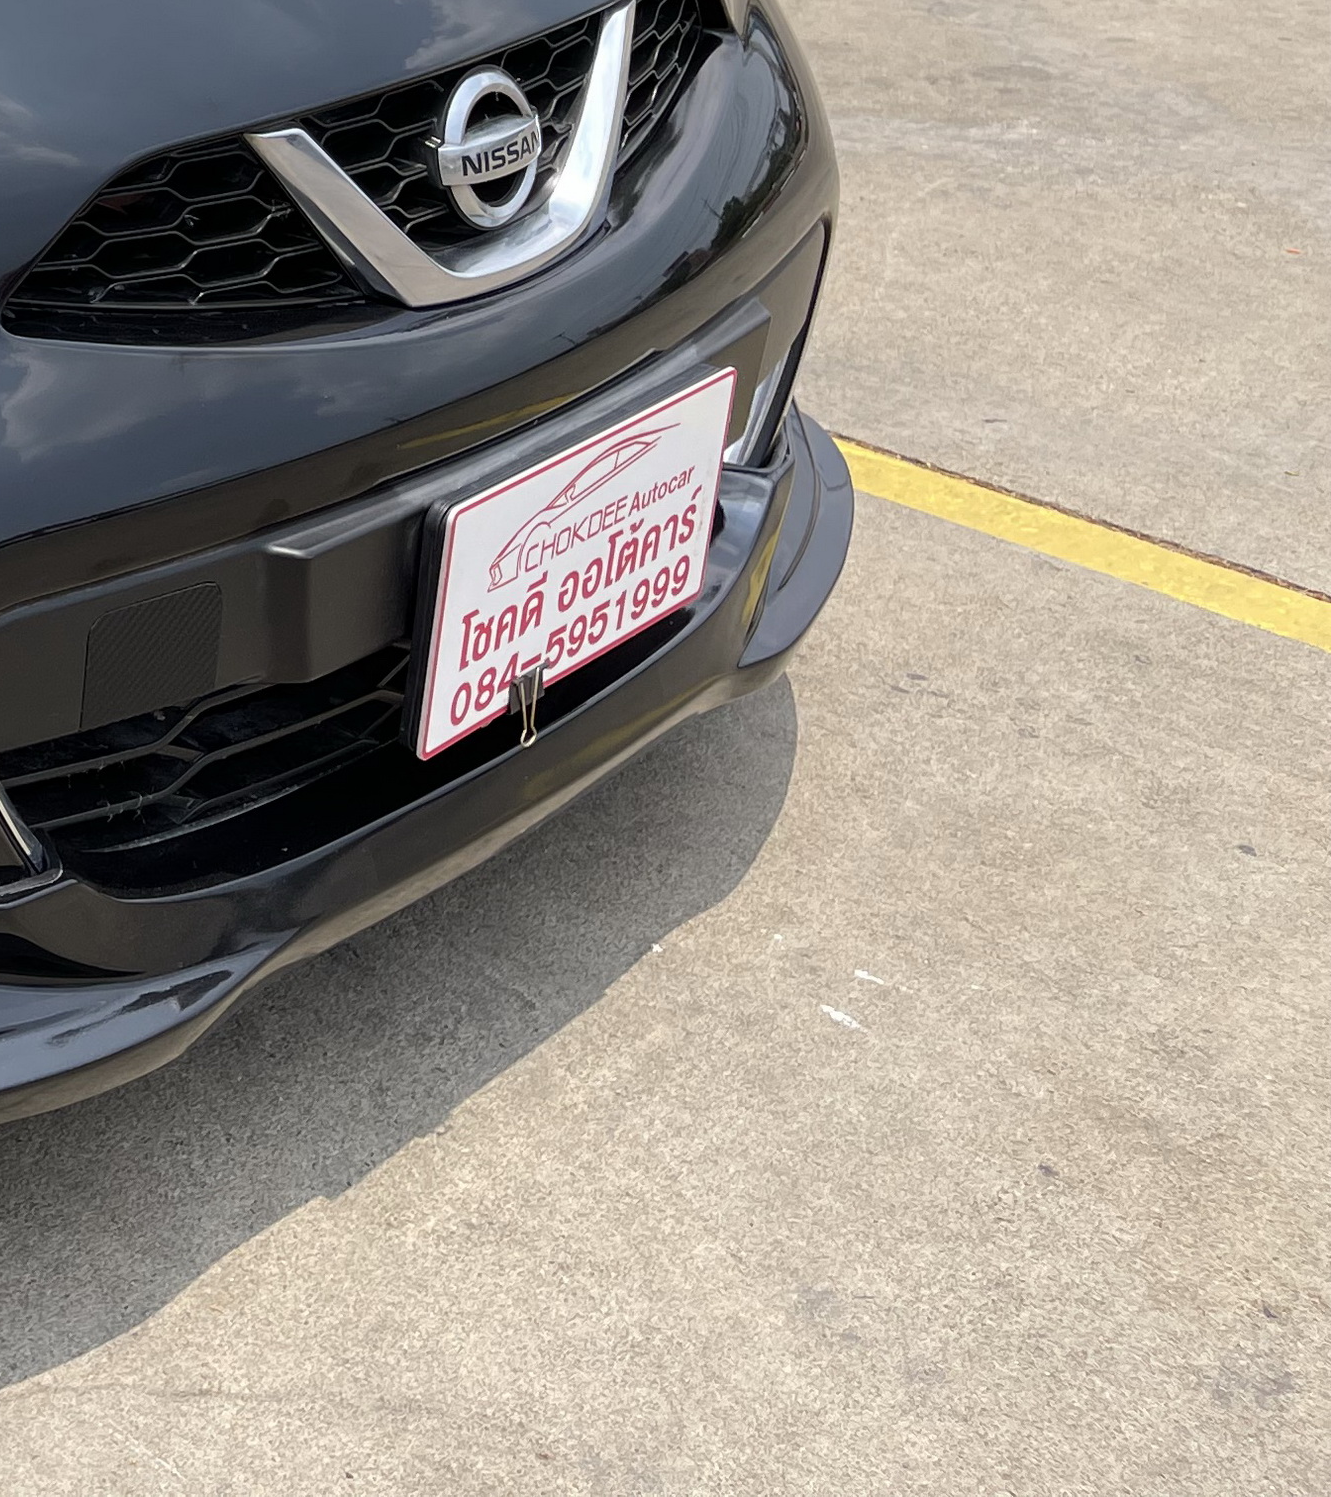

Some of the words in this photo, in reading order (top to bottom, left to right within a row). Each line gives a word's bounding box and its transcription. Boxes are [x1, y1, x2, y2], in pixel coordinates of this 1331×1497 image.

[459, 570, 548, 672] โชคดี
[558, 485, 702, 613] ออโต้คาร์
[524, 496, 628, 573] CHOKDEE
[628, 466, 695, 517] Autocar
[450, 555, 690, 727] 084-5951999
